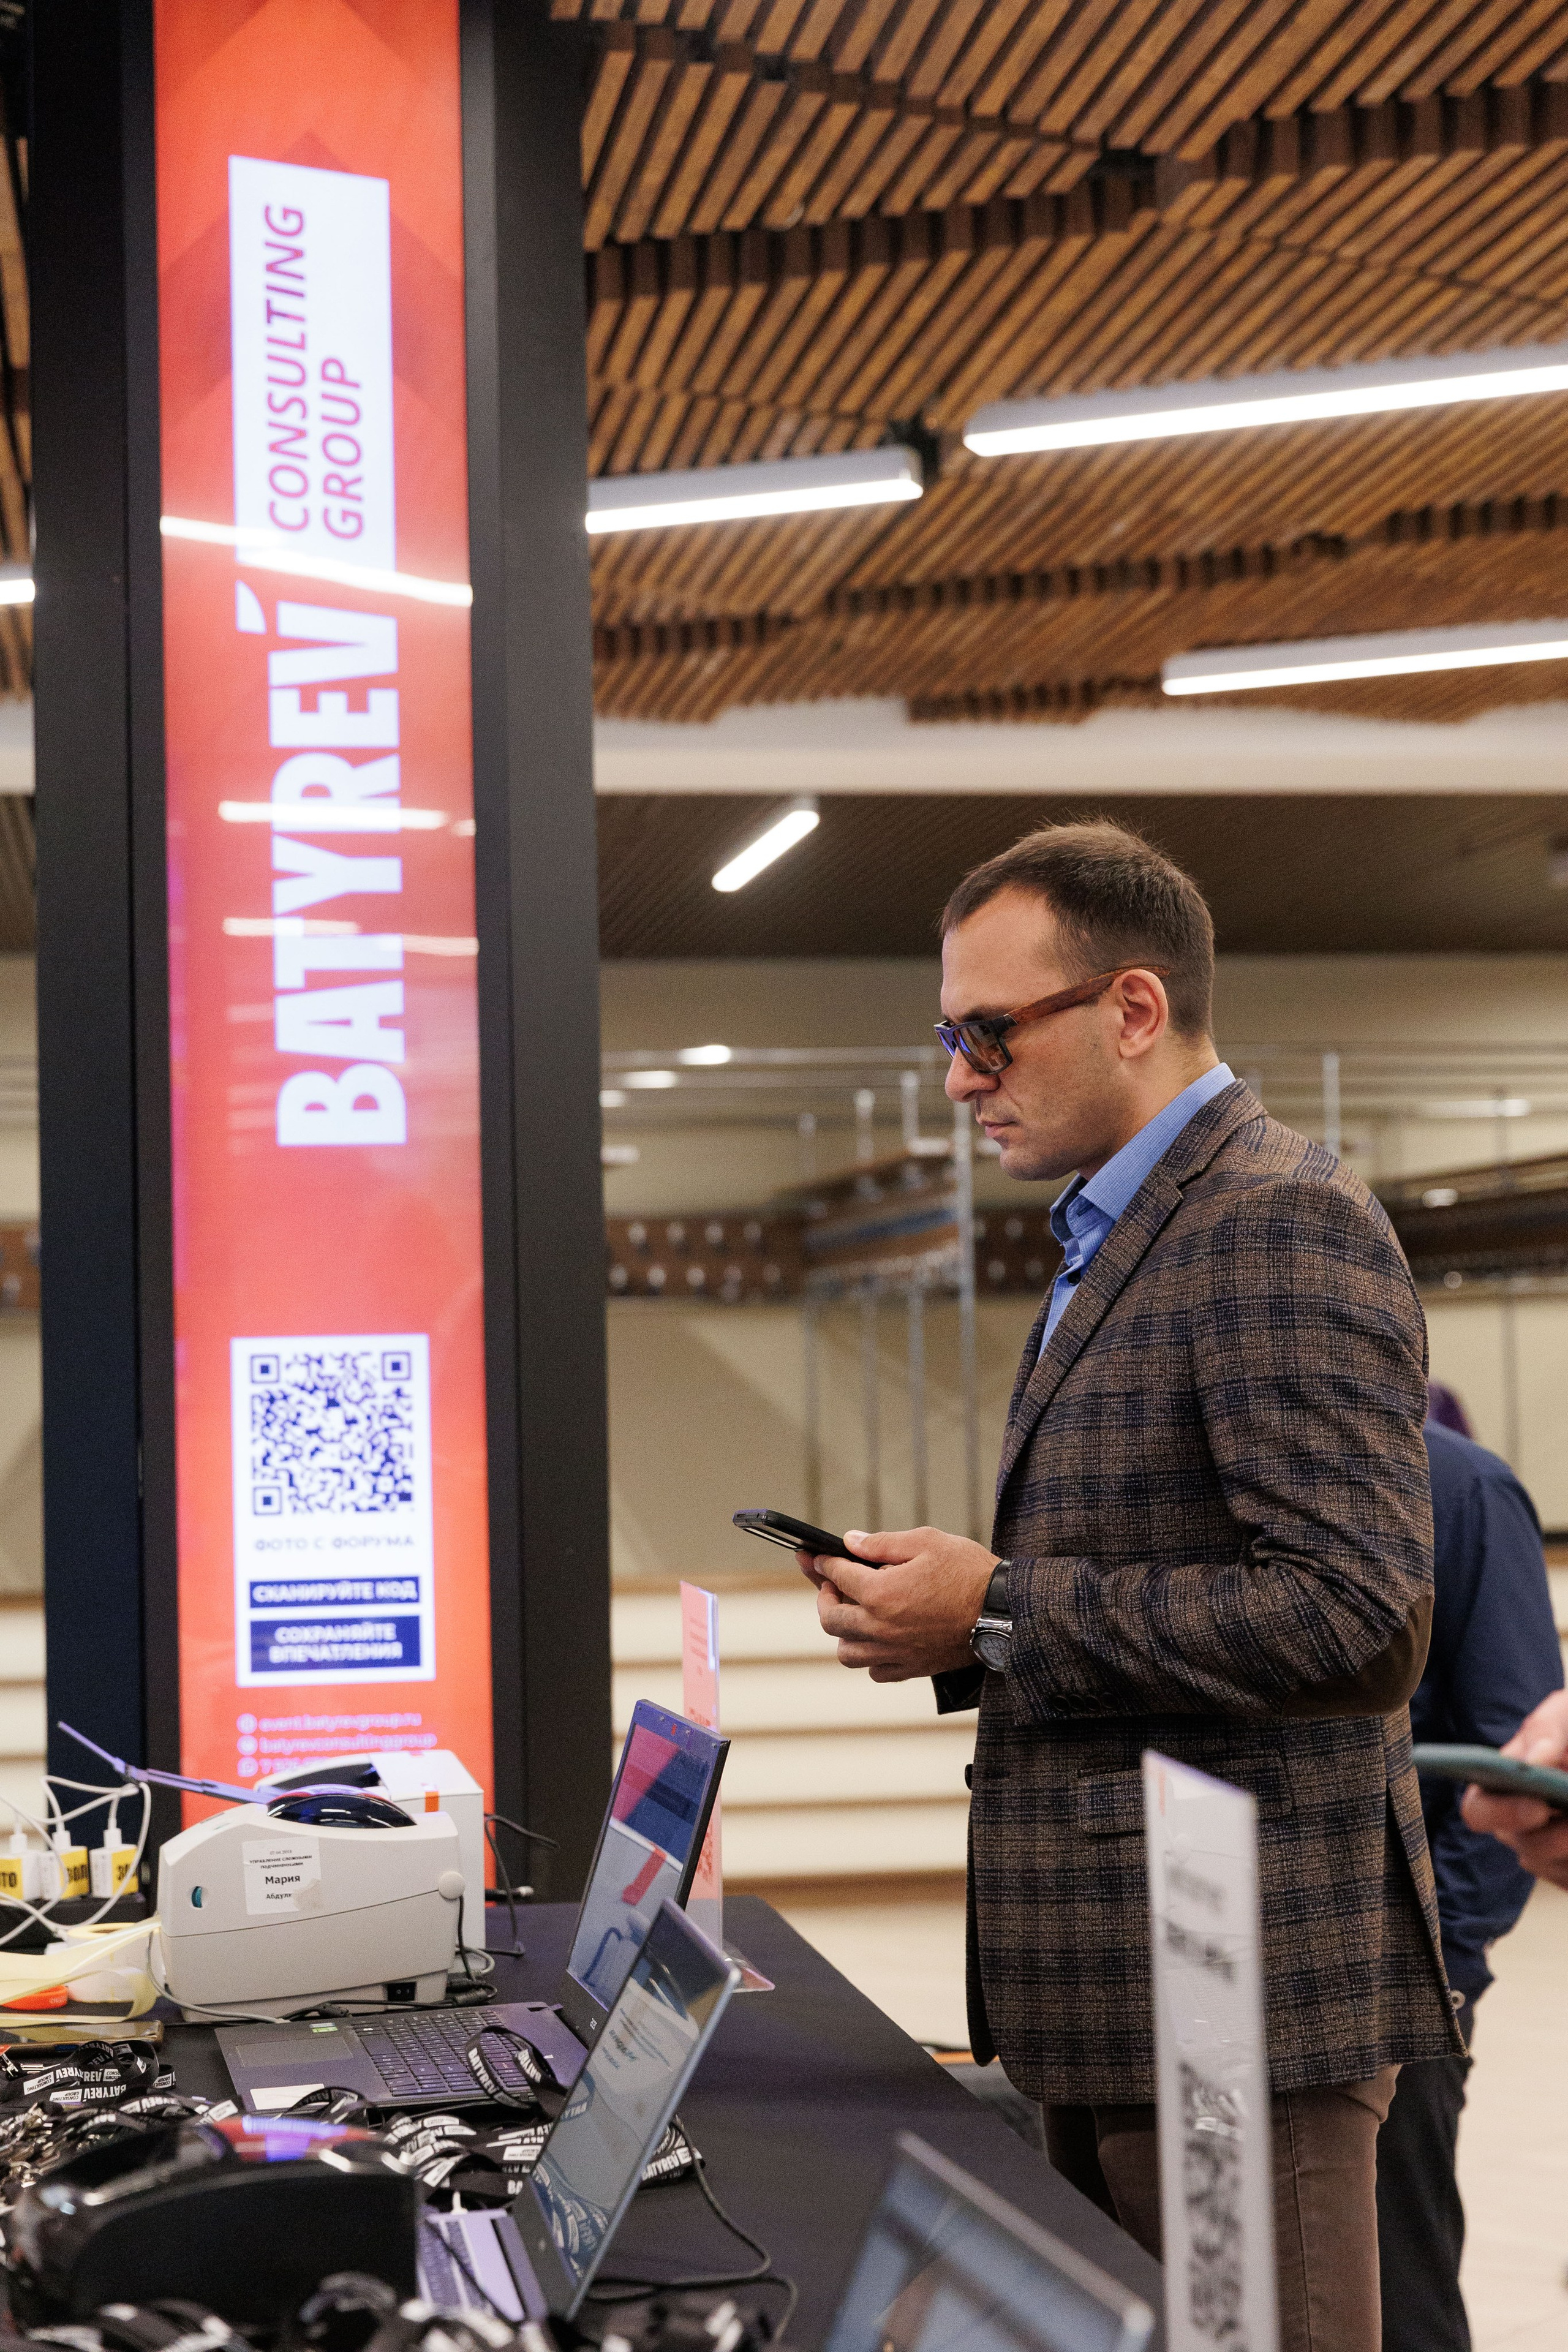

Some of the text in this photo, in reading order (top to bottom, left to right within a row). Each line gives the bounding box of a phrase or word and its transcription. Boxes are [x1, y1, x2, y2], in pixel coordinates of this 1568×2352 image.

[264, 204, 310, 532] CONSULTING
[321, 357, 364, 541] GROUP
[255, 1538, 308, 1551] ФОТО
[252, 1580, 418, 1602] СКАНИРУЙТЕ КОД
[265, 1875, 301, 1885] Мария
[37, 2075, 51, 2084] GROUP
